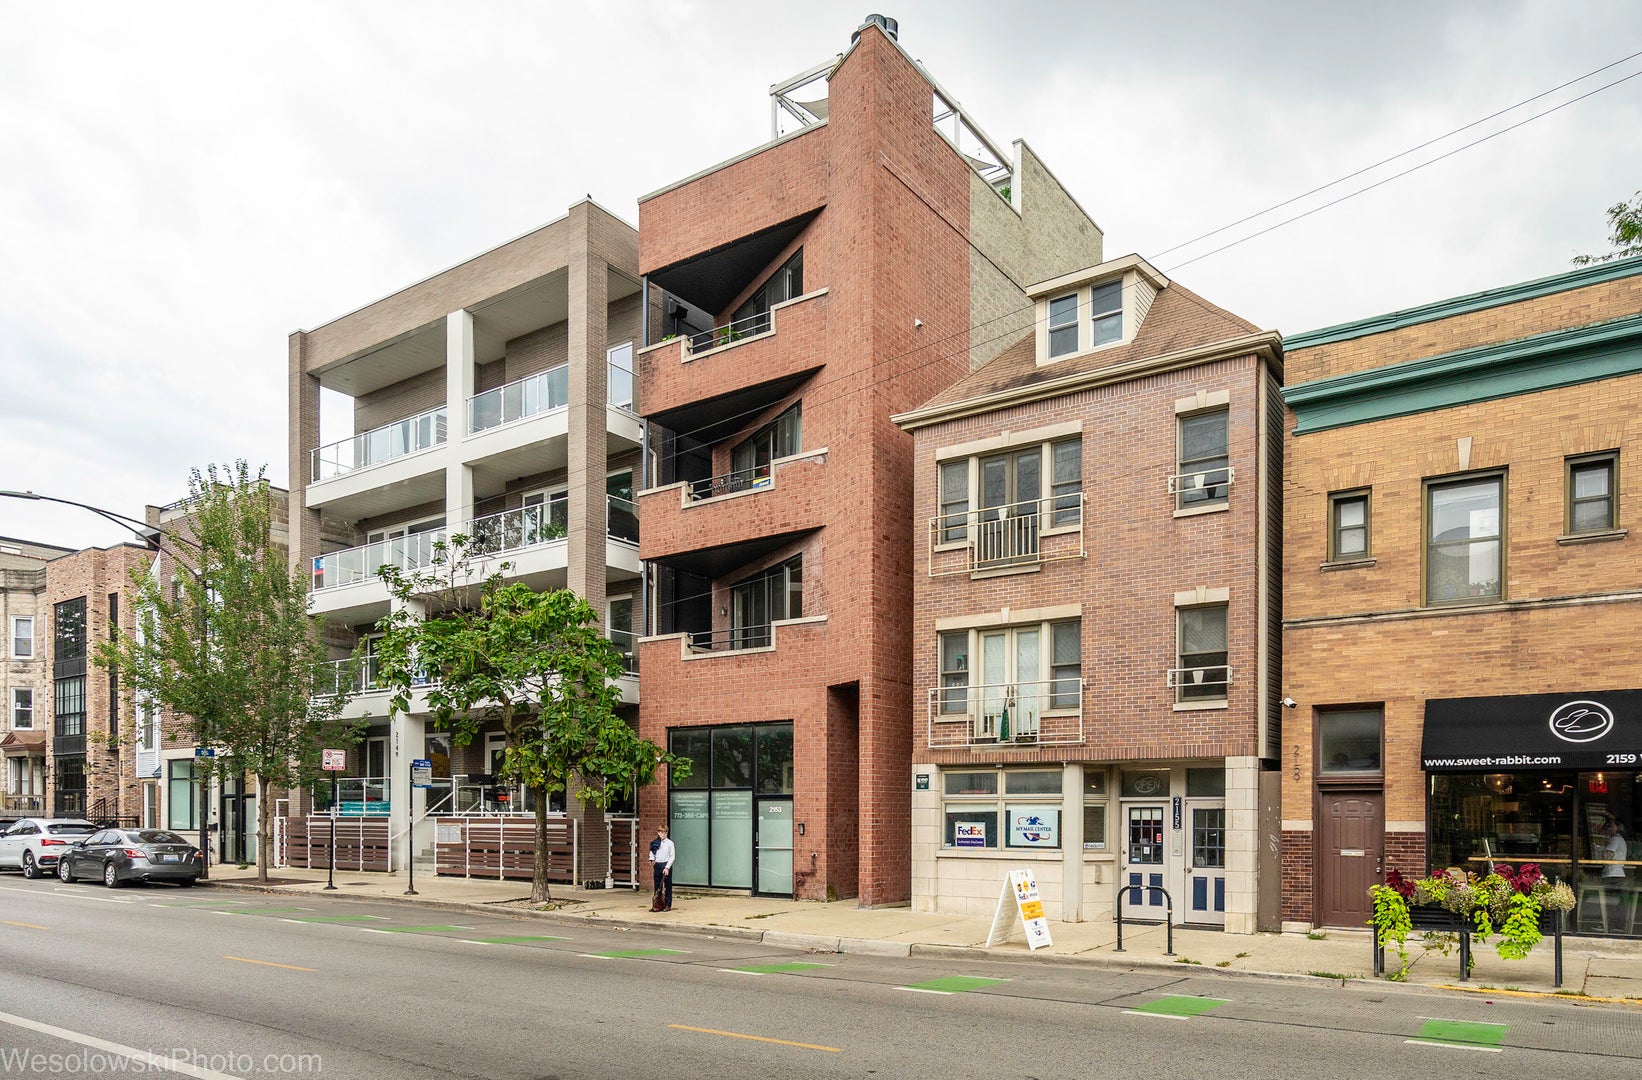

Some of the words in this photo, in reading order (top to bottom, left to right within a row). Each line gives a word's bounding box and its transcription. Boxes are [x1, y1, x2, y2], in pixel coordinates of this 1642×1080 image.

[1424, 755, 1561, 767] www.sweet-rabbit.com
[1606, 754, 1637, 764] 2159
[957, 826, 983, 836] FedEx
